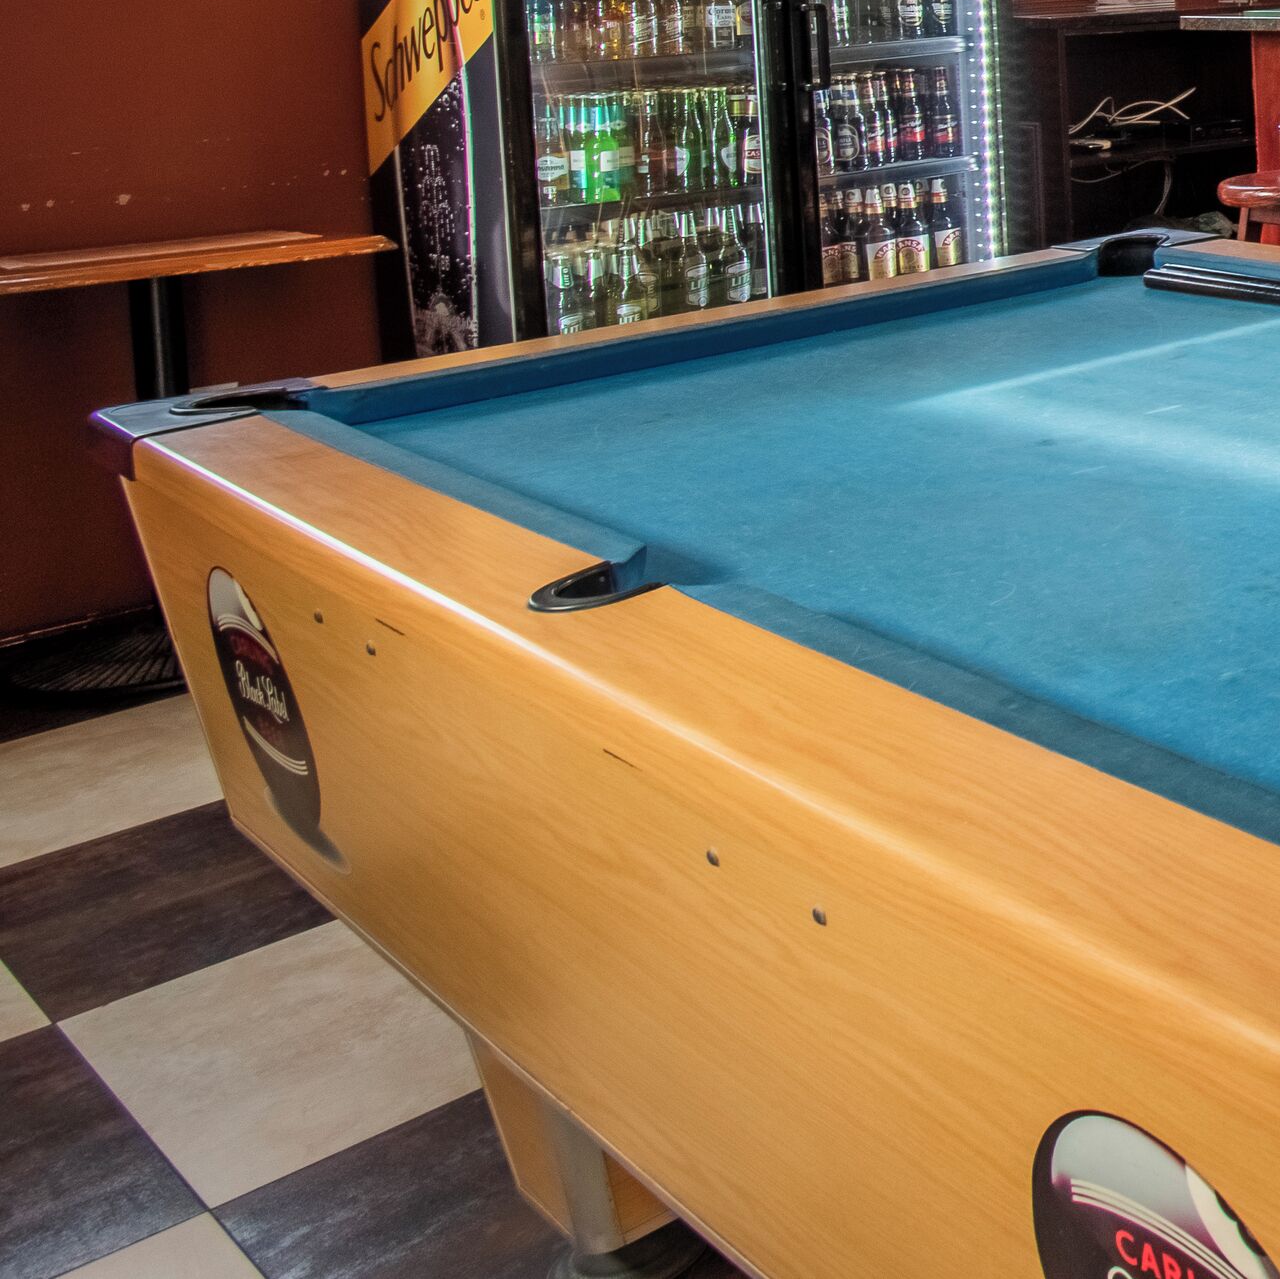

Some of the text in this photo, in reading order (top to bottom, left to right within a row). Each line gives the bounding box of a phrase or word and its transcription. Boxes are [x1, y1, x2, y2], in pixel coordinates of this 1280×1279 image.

[943, 230, 961, 246] HAN
[876, 242, 895, 259] HAN
[619, 314, 640, 325] LITE
[235, 660, 290, 724] Black Label
